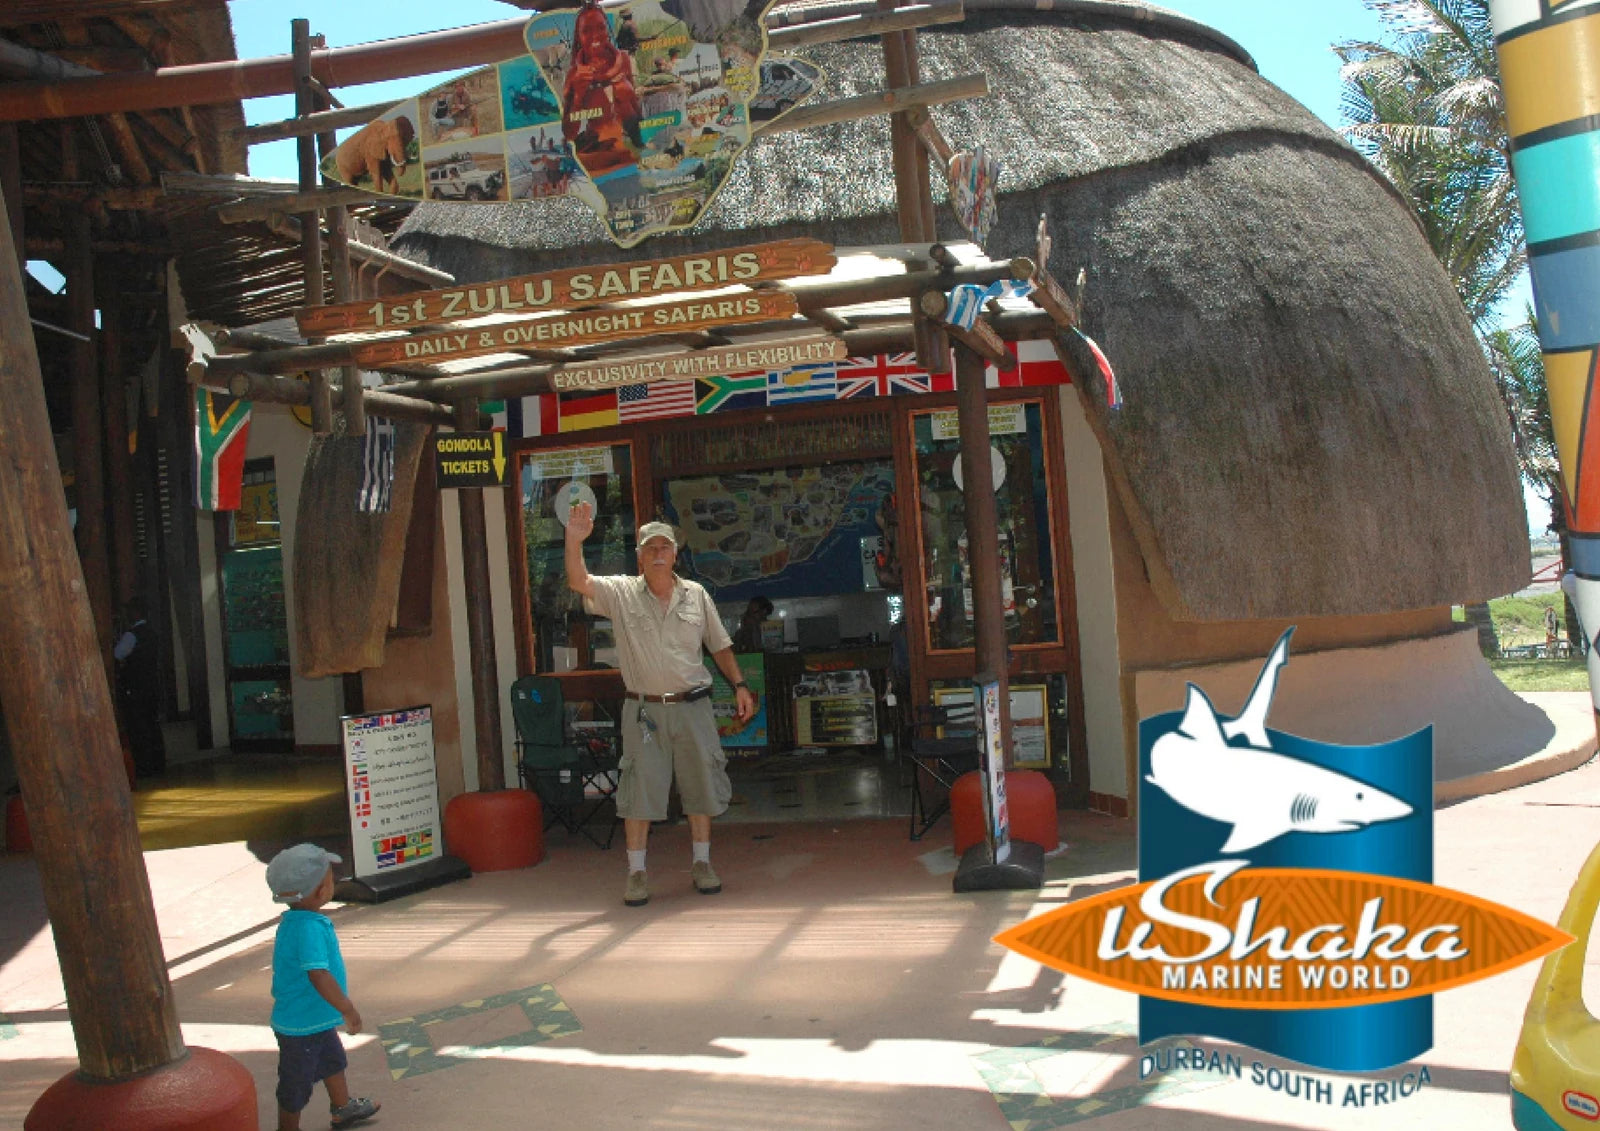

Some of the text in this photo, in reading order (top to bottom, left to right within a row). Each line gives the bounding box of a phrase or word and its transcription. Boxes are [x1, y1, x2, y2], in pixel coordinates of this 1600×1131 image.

[368, 252, 761, 326] 1st ZULU SAFARIS
[405, 298, 761, 357] DAILY & OVERNIGHT SAFARIS
[554, 341, 837, 388] EXCLUSIVITY WITH FLEXIBILITY
[437, 438, 492, 453] GONDOLA
[441, 459, 490, 475] TICKETS
